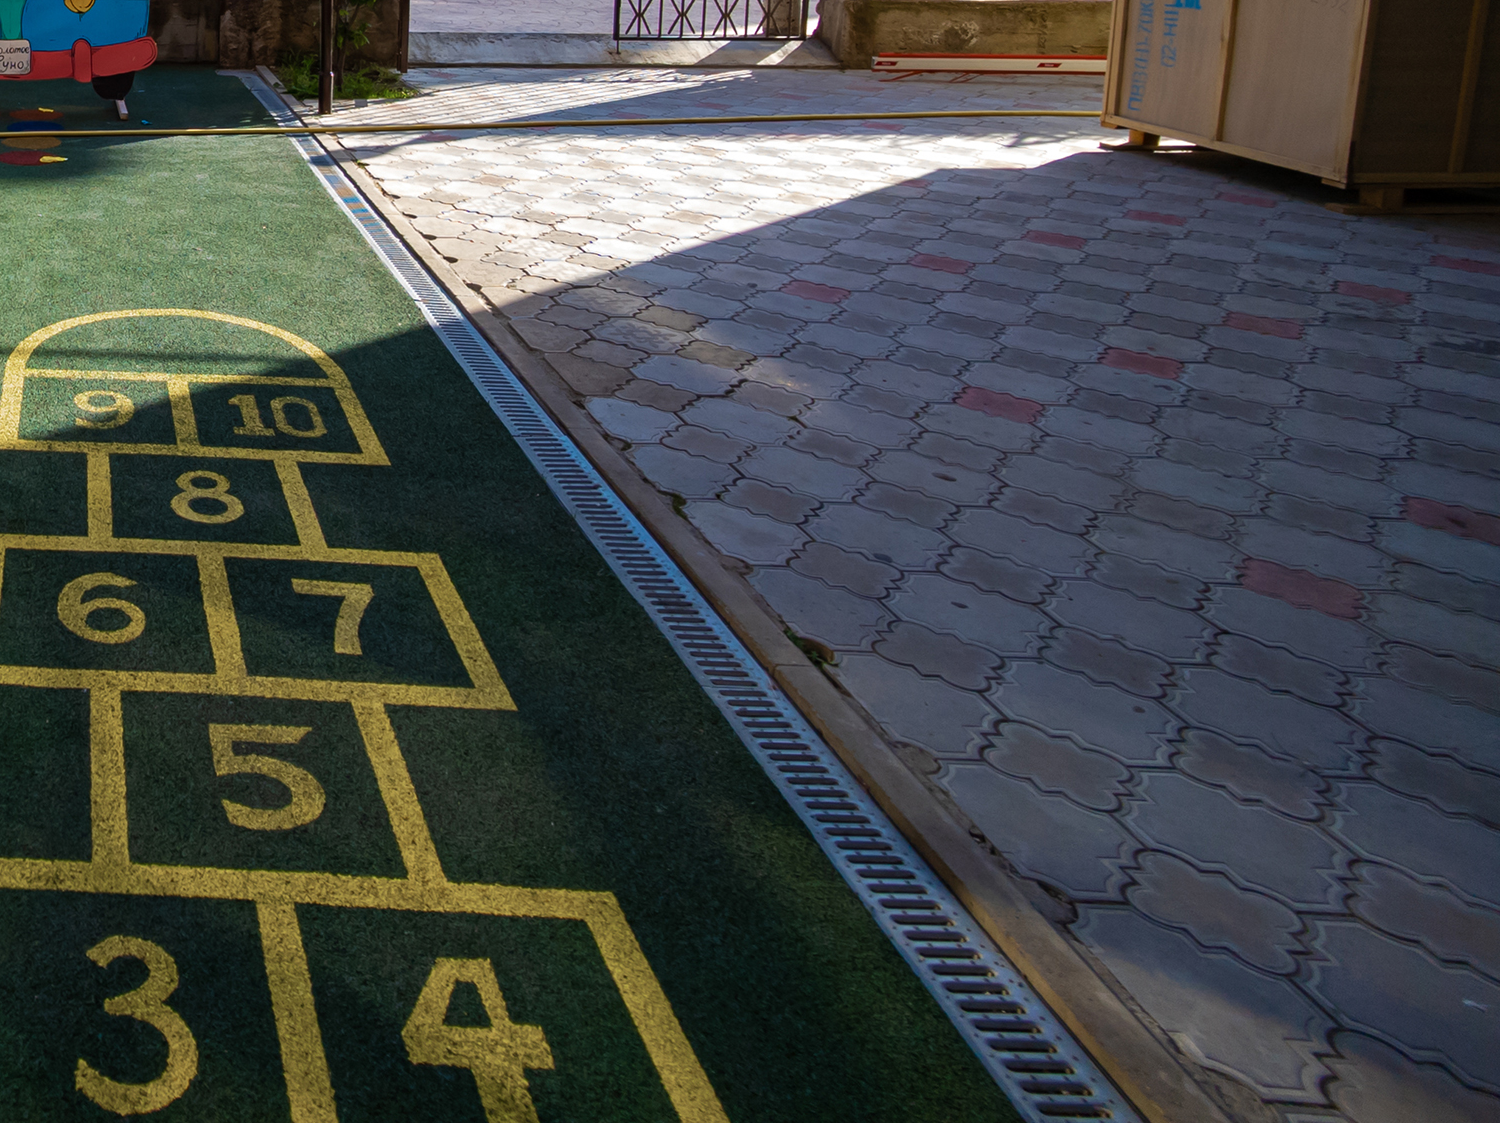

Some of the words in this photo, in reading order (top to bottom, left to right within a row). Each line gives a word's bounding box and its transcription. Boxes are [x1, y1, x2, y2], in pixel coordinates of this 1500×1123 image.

[73, 389, 134, 430] 9
[228, 394, 328, 439] 10
[169, 470, 245, 525] 8
[56, 571, 146, 645] 6
[291, 578, 375, 656] 7
[208, 723, 327, 831] 5
[74, 934, 199, 1117] 3
[401, 957, 555, 1123] 4
